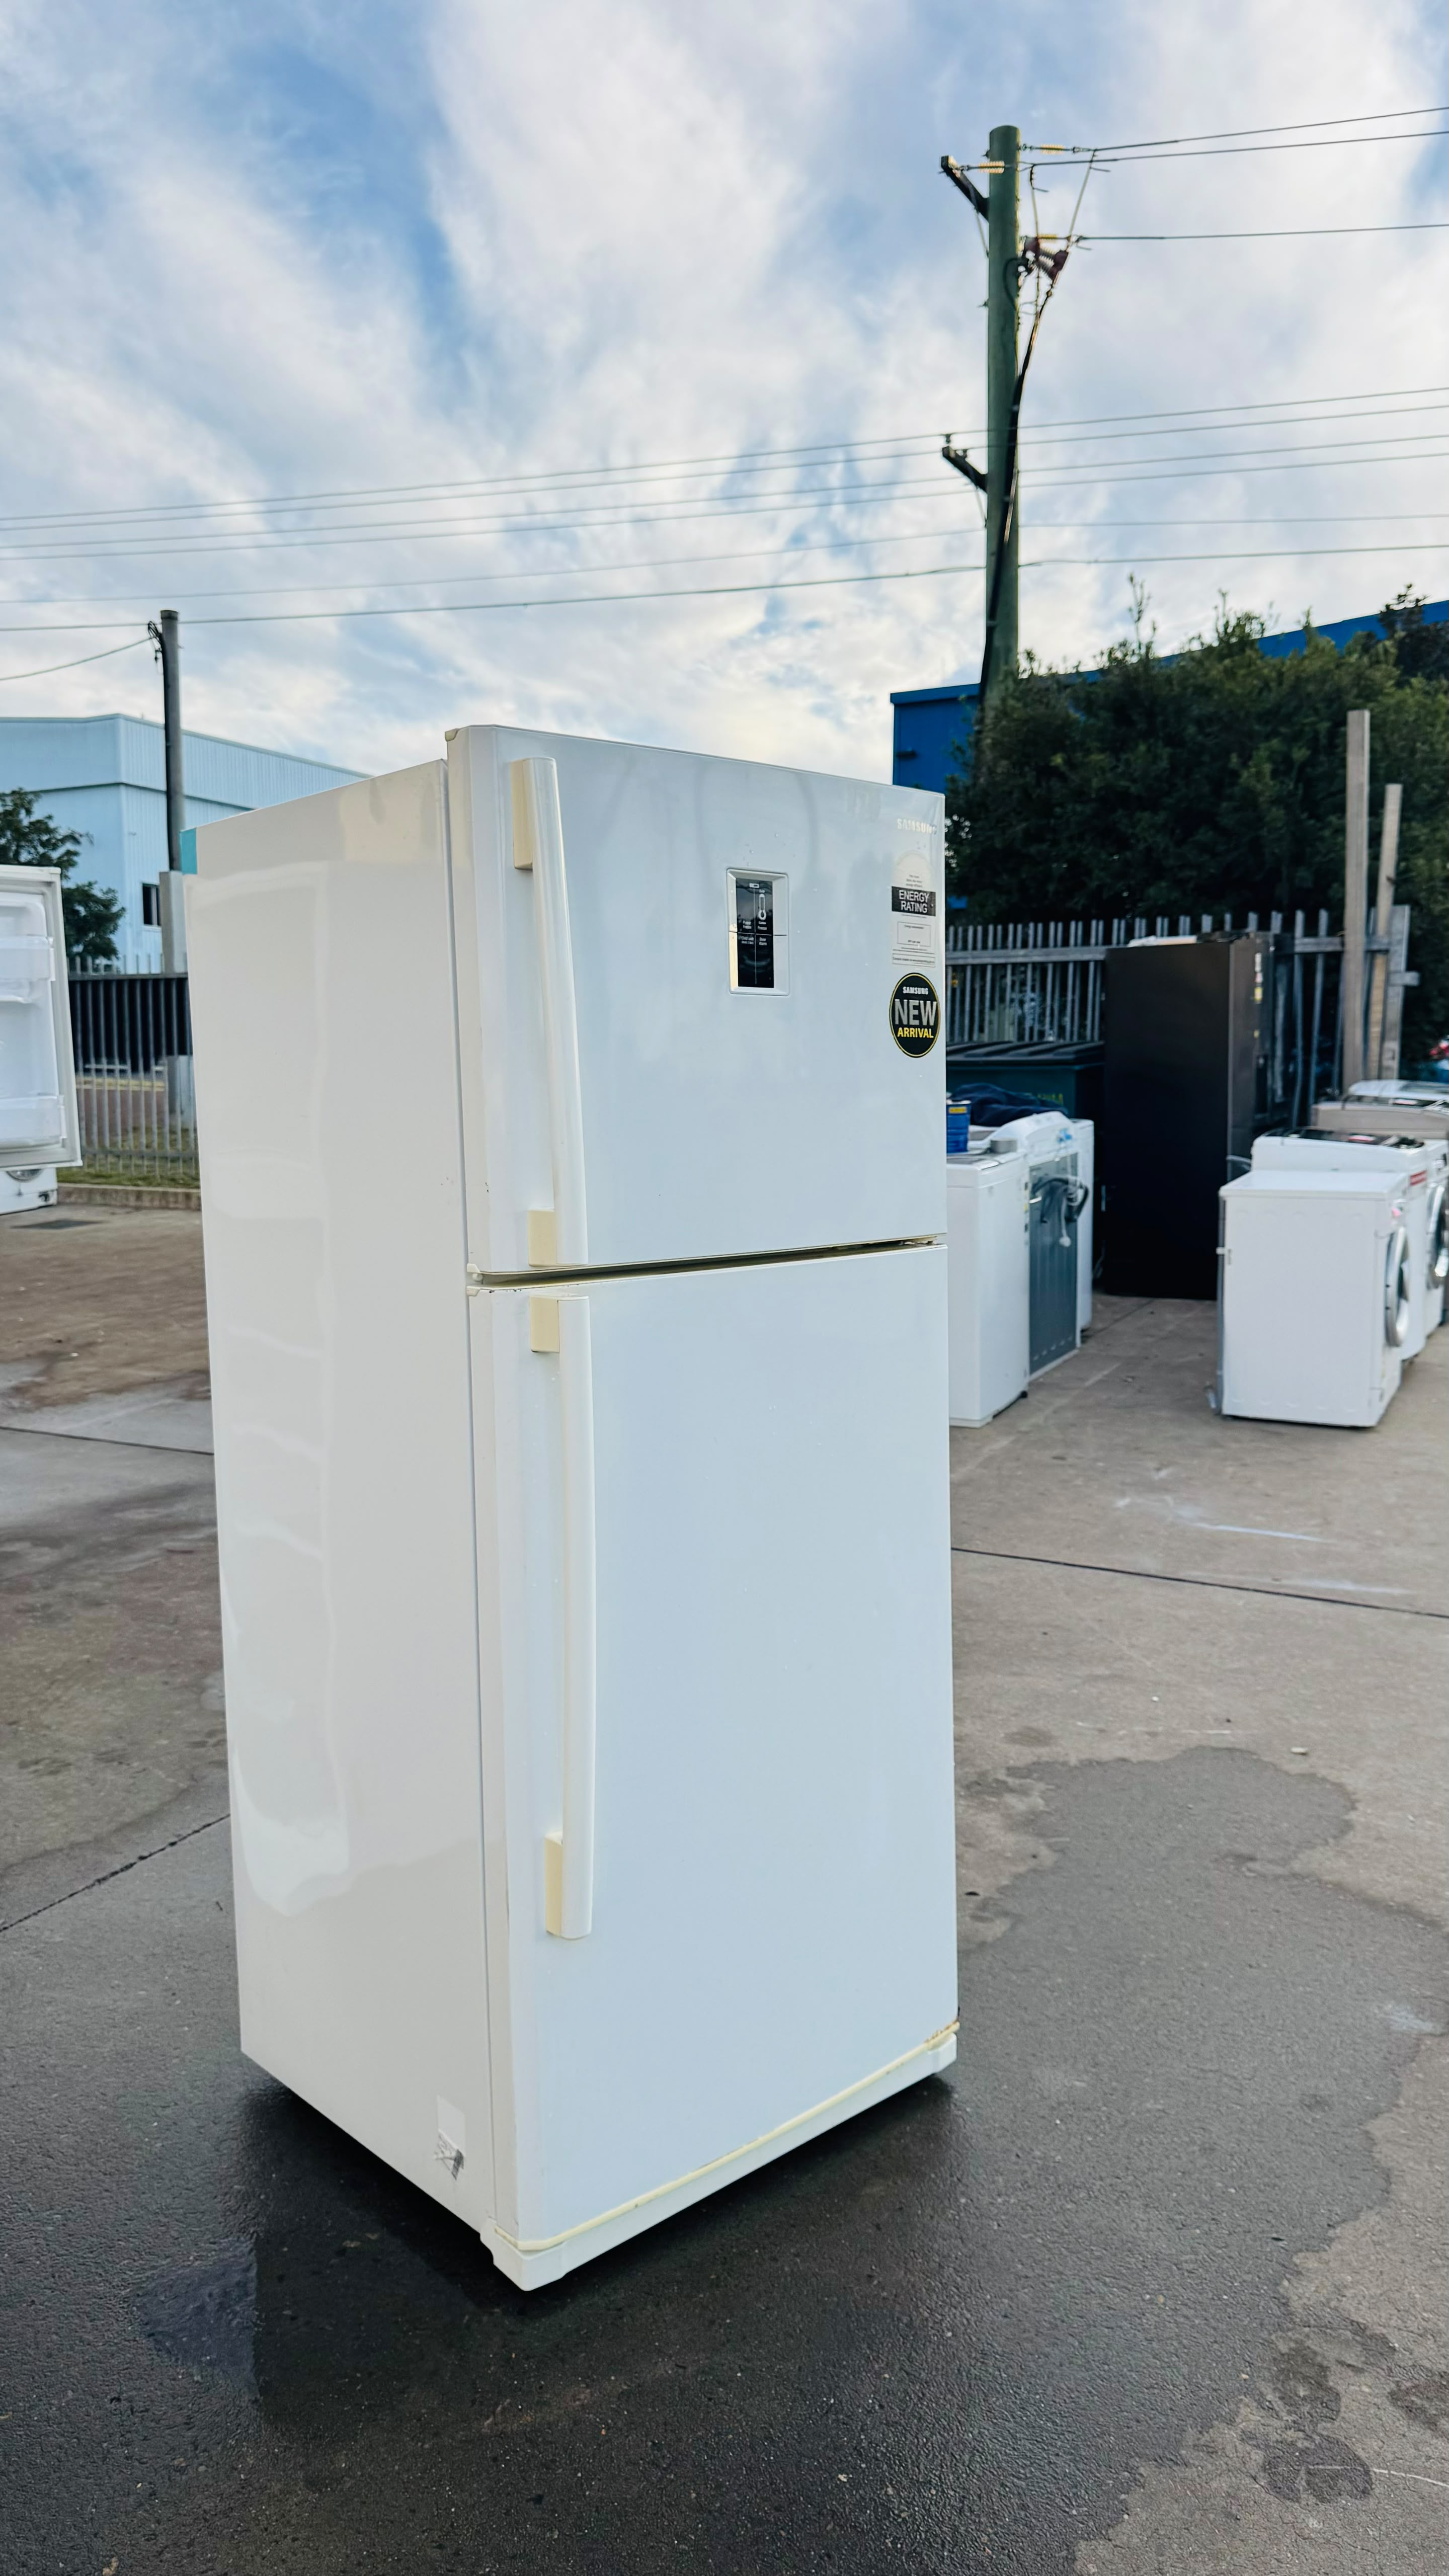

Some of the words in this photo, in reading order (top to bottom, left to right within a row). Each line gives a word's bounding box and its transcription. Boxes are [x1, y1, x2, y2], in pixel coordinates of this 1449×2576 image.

[899, 890, 929, 903] ENERGY
[901, 901, 927, 913] RATING
[903, 986, 928, 995] SAMSUNG
[895, 999, 937, 1026] NEW
[897, 1027, 934, 1038] ARRIVAL
